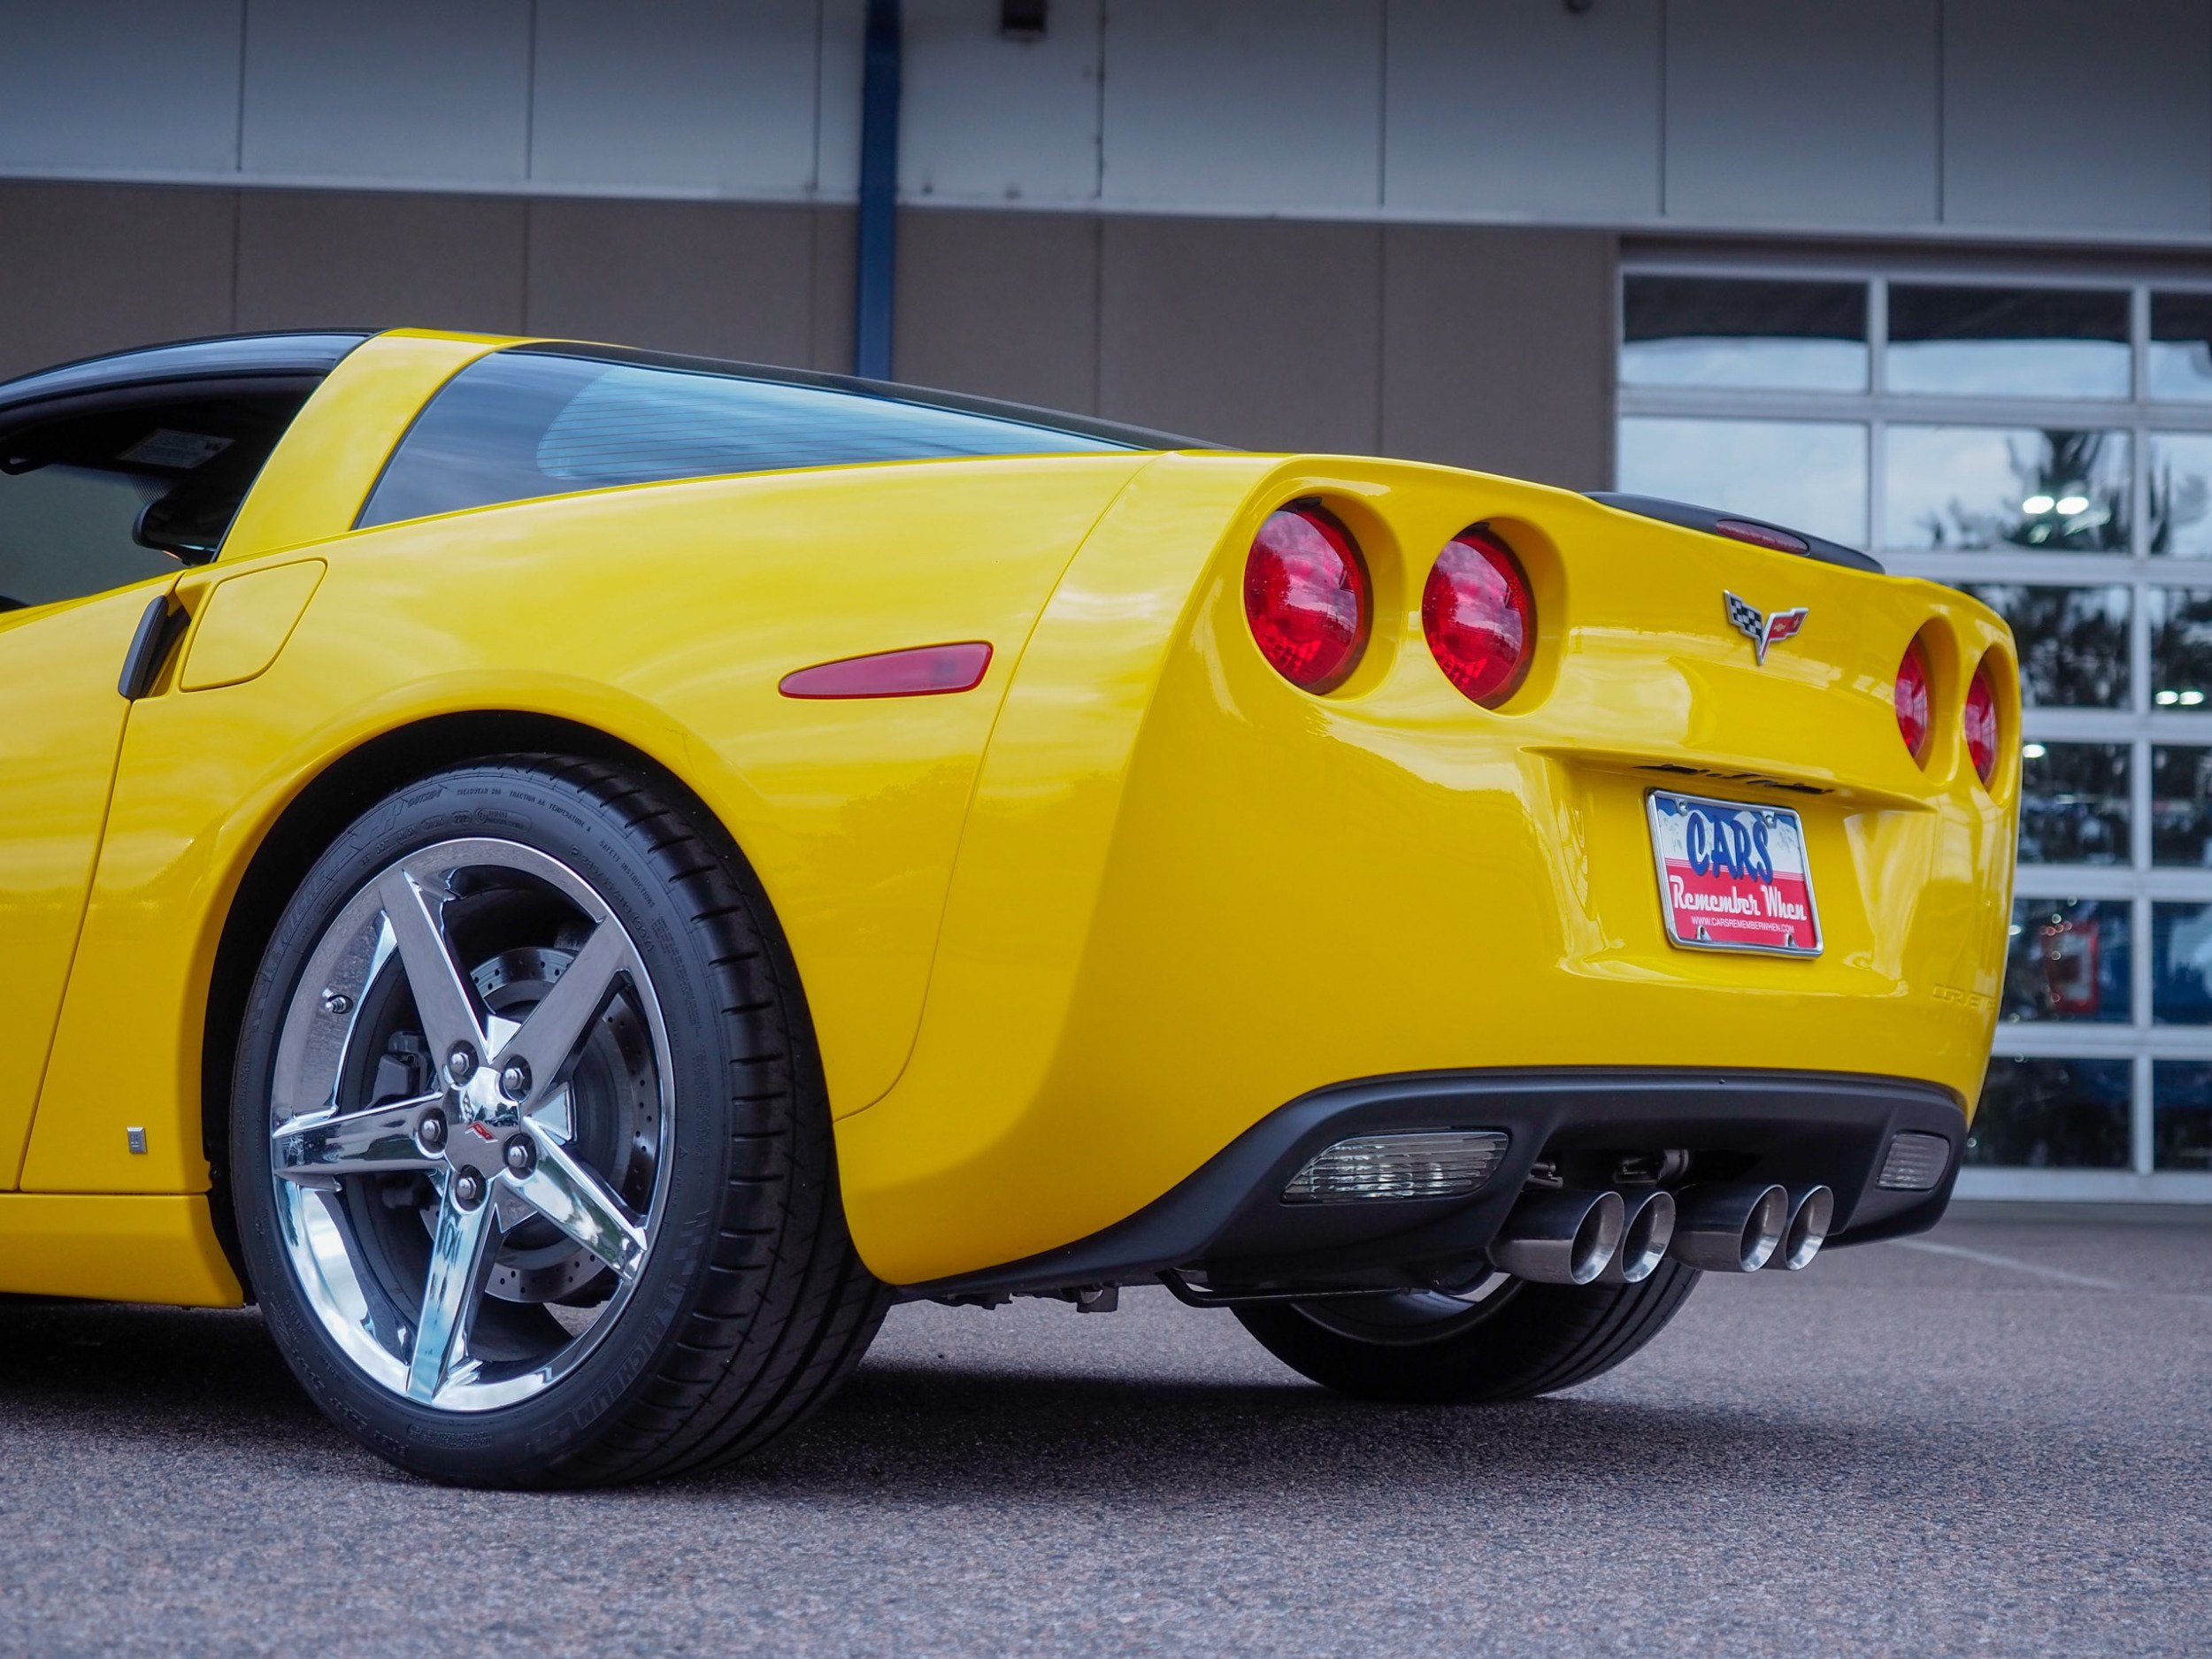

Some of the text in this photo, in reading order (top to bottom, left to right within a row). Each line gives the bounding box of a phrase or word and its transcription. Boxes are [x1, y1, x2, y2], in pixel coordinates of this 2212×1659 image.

[509, 788, 535, 804] TRACTION
[549, 801, 585, 829] TEMPERATURE
[1686, 812, 1773, 884] CARS
[598, 838, 656, 910] SAFETY INSTRUCTIONS
[1670, 876, 1807, 921] Remember When
[1691, 917, 1794, 933] WWW.CARSREMEMBERWHEN.COM
